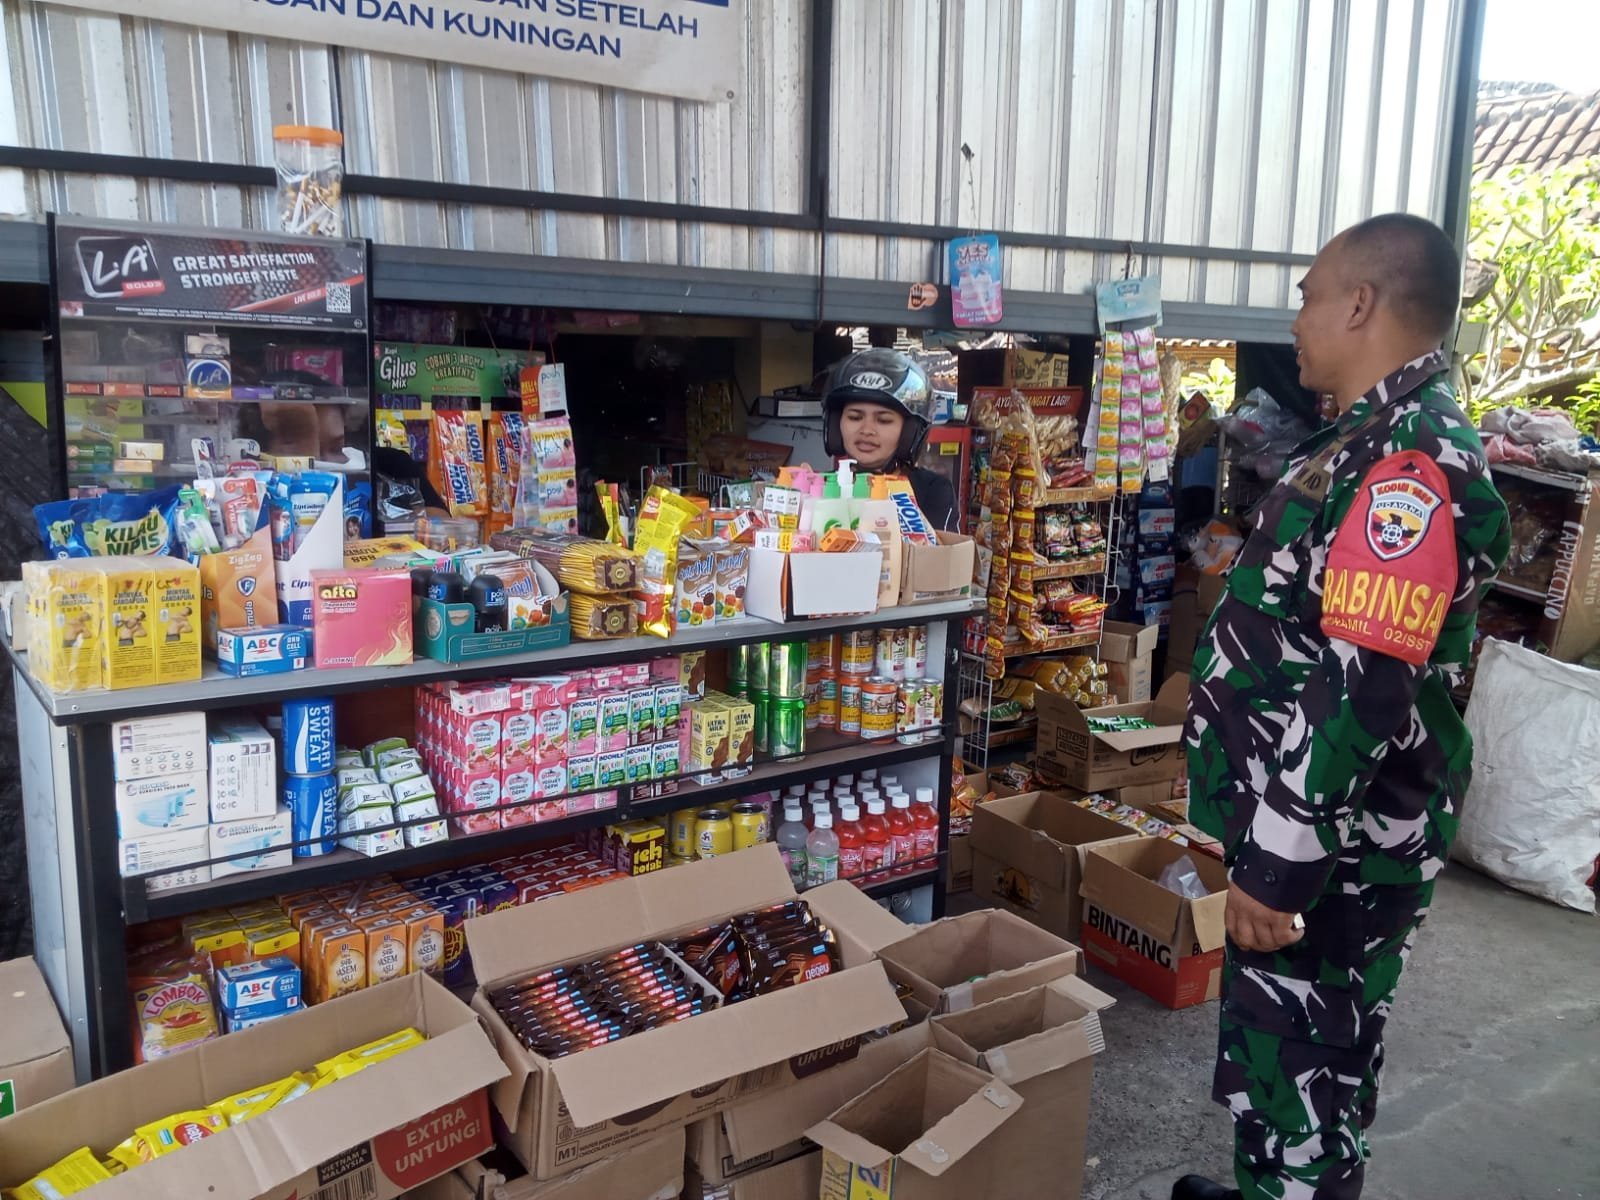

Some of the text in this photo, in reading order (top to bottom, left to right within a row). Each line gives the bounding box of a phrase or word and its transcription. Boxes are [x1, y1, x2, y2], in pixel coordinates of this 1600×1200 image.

[356, 3, 434, 30] DAN
[443, 10, 622, 58] KUNINGAN
[555, 0, 699, 38] SETELAH
[173, 255, 227, 272] GREAT
[180, 268, 299, 289] STRONGER TASTE
[380, 355, 417, 381] Gilus
[391, 378, 407, 390] Mix
[891, 493, 925, 533] WOW
[105, 514, 160, 542] KILAU
[106, 532, 161, 557] NIPIS
[227, 554, 263, 566] ZigZag
[321, 585, 356, 599] afta
[1321, 568, 1447, 638] BABINSA
[246, 637, 278, 650] ABC
[1383, 627, 1433, 652] 02/SST
[309, 706, 322, 764] SWEAT
[321, 705, 331, 768] POCARI
[323, 789, 334, 836] SWEA
[634, 841, 663, 865] teh
[633, 860, 663, 876] kotak
[1087, 904, 1173, 970] BINTANG
[377, 955, 398, 966] ASEM
[417, 944, 437, 955] ASEM
[336, 965, 357, 975] ASEM
[145, 983, 206, 1017] LOMBOK
[240, 981, 271, 995] ABC
[406, 1107, 467, 1148] EXTRA
[395, 1119, 481, 1173] UNTUNG!
[558, 1146, 577, 1162] M1
[319, 1151, 361, 1175] VIETNAM
[321, 1157, 365, 1181] MALAYSIA
